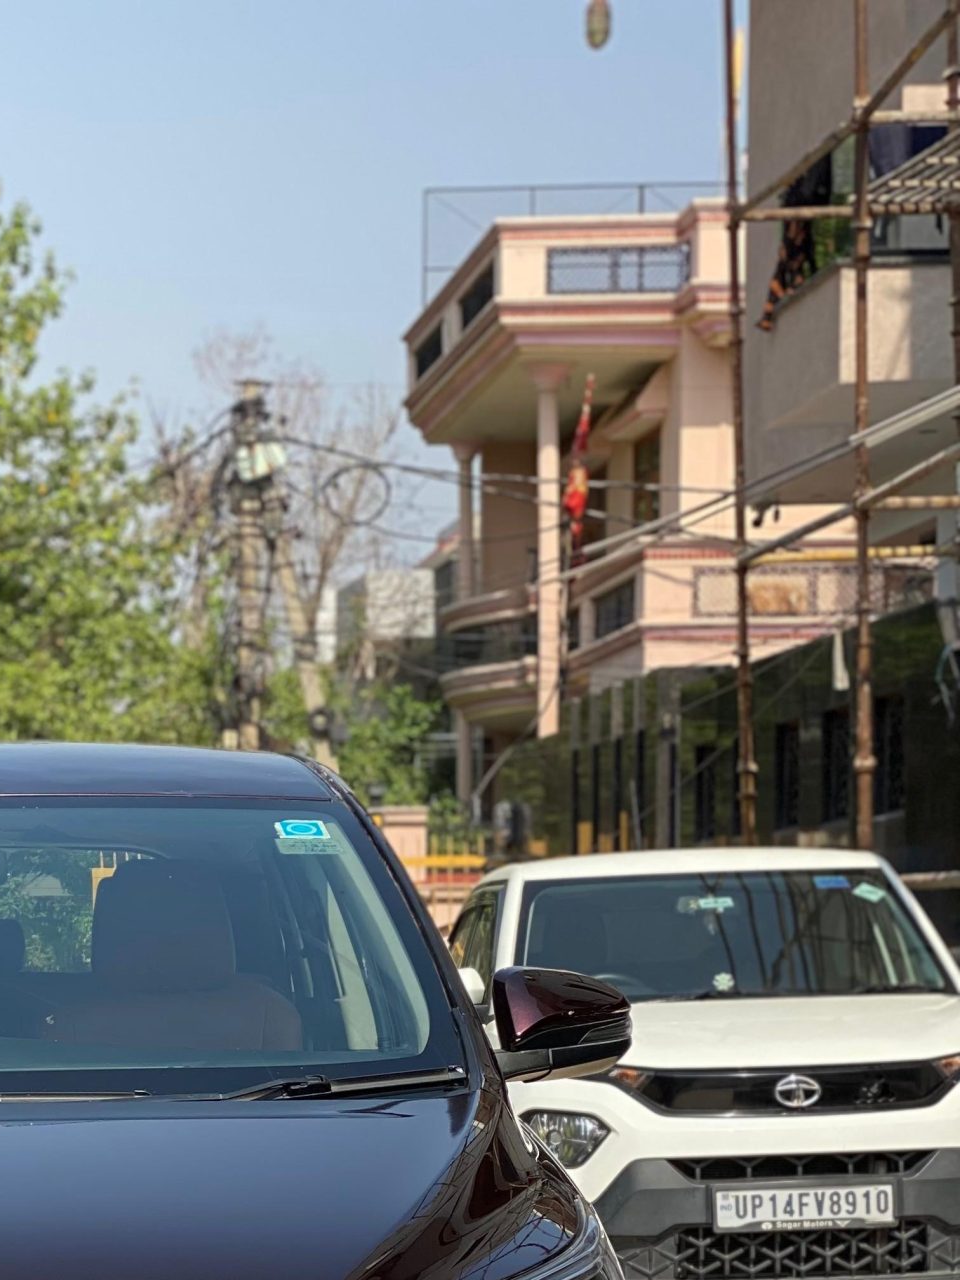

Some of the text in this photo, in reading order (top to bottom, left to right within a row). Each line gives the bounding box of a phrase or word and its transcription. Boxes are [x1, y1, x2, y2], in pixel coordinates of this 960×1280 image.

[734, 1189, 889, 1219] UP14FV8910
[776, 1219, 833, 1230] Sagar Motors
